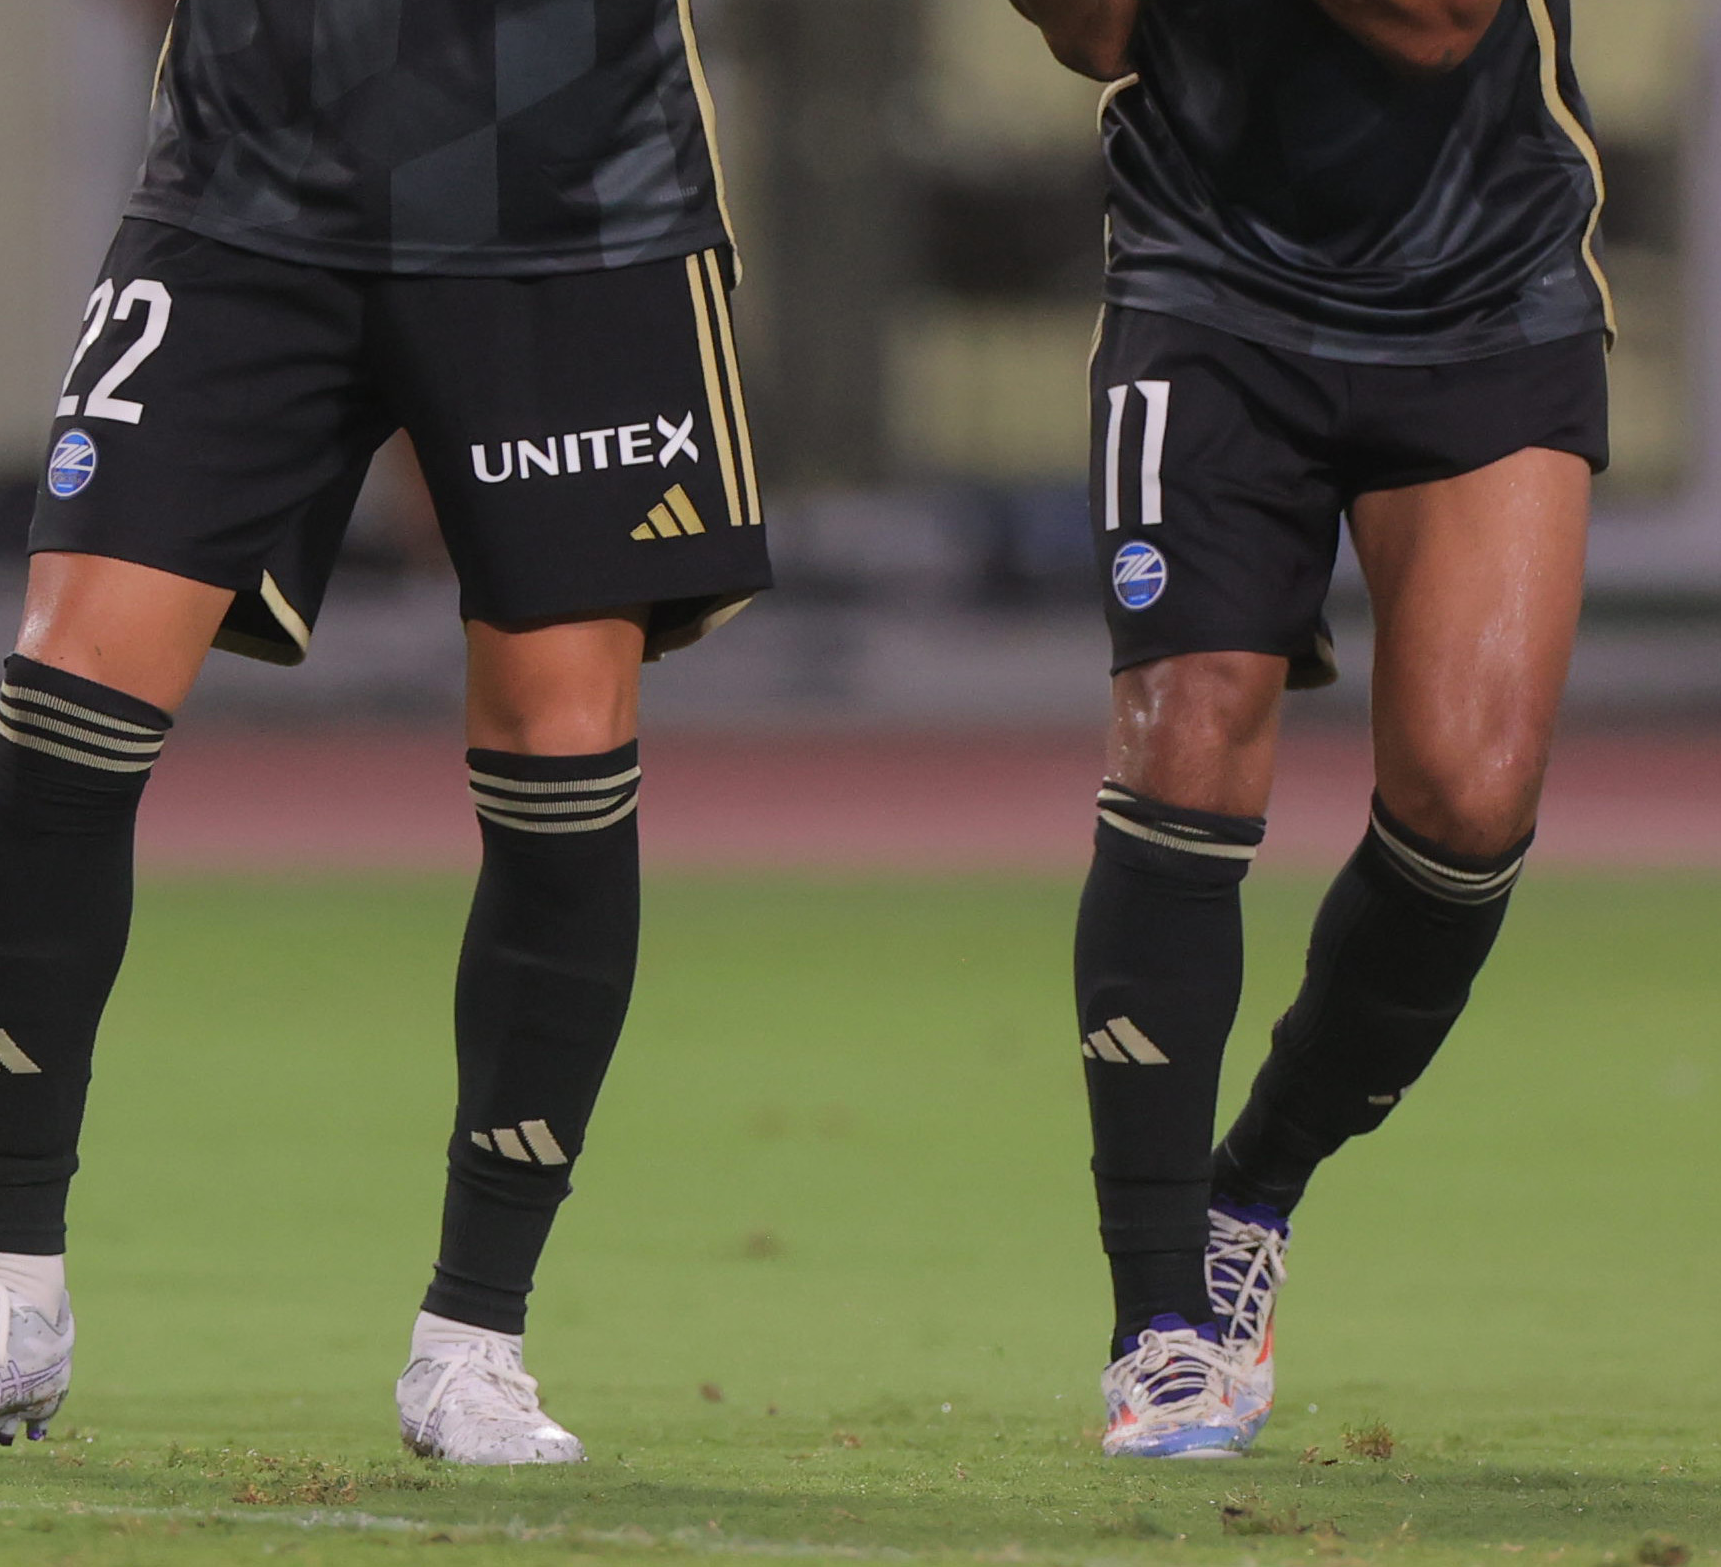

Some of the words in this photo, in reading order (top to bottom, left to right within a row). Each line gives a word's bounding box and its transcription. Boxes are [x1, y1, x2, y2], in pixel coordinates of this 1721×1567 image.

[56, 278, 173, 425] 22
[470, 410, 700, 484] UNITEX
[1105, 380, 1171, 531] 11
